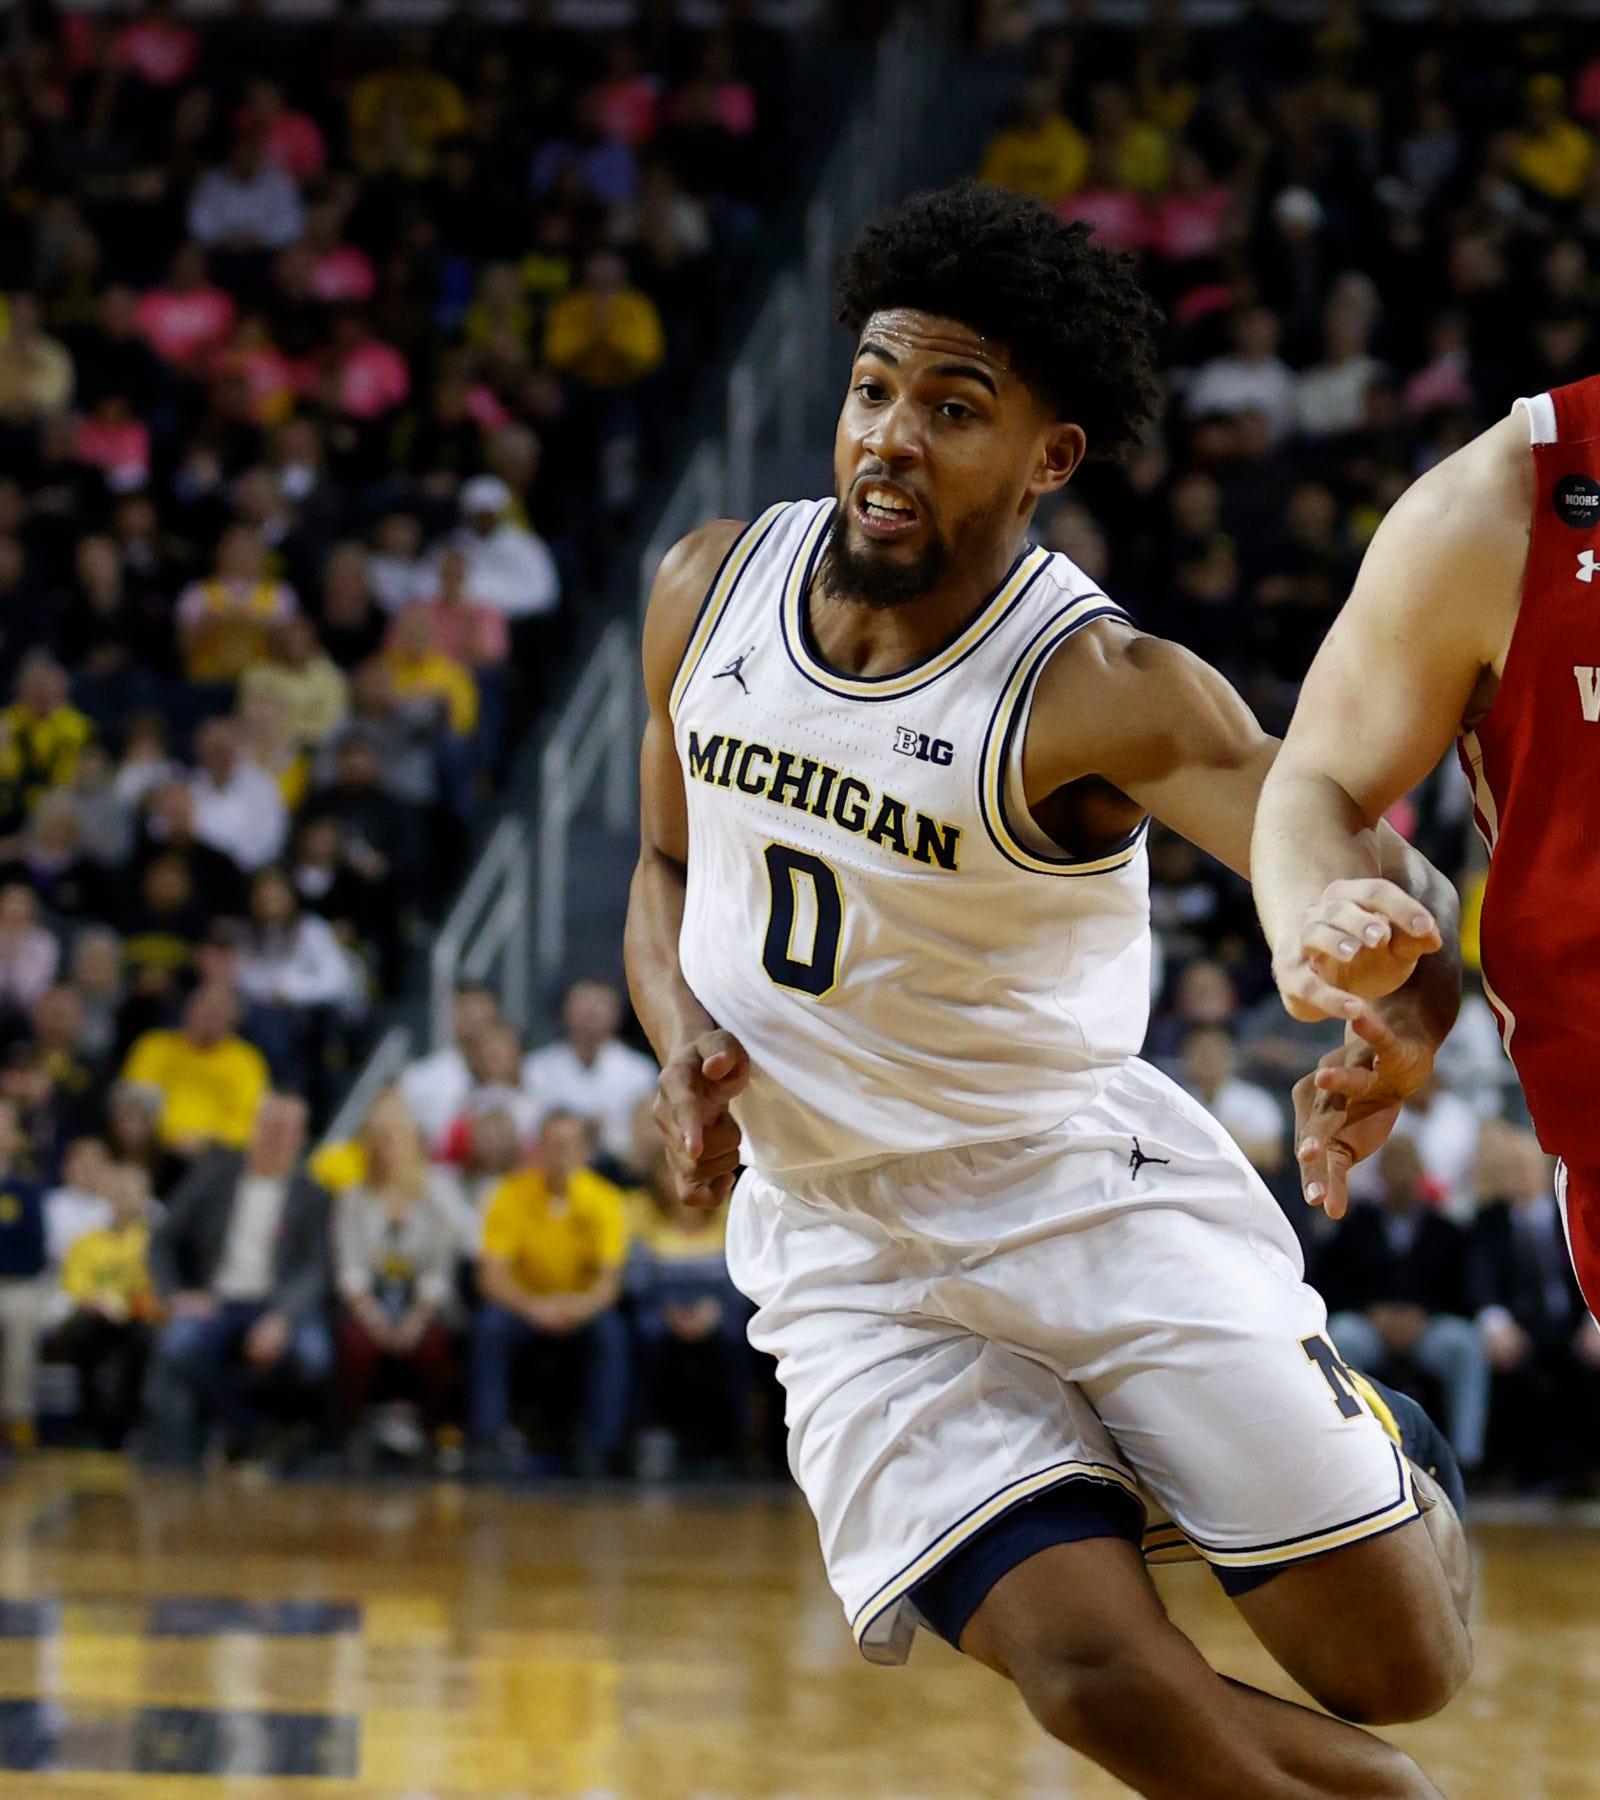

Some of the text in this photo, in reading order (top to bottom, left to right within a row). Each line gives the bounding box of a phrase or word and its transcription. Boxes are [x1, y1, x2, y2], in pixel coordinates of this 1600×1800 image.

[1565, 494, 1599, 506] MOORE
[688, 730, 964, 873] MICHIGAN
[762, 839, 845, 1001] 0
